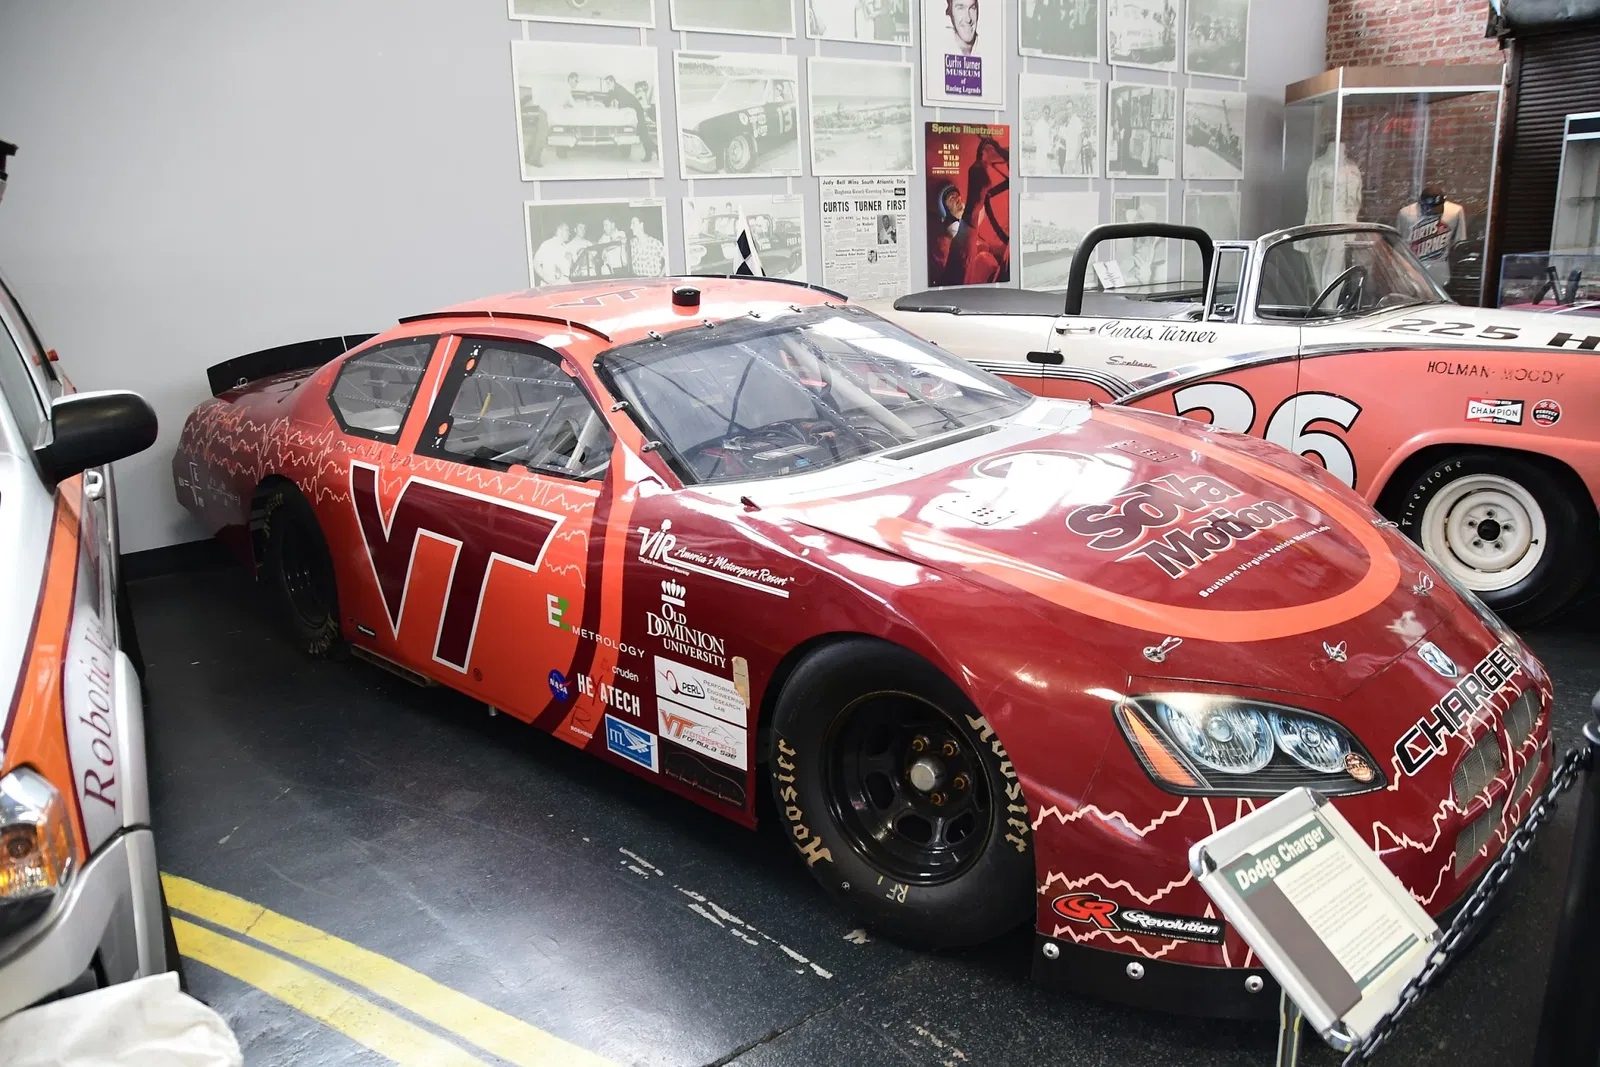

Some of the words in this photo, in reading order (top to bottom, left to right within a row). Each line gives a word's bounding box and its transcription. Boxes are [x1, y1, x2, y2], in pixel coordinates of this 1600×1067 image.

[945, 54, 962, 69] Curtis
[963, 57, 980, 70] Turner
[945, 69, 980, 78] MUSEUM
[945, 85, 962, 93] Racing
[962, 86, 980, 94] Legends
[932, 124, 960, 134] Sports
[963, 125, 1004, 136] Illustrated
[823, 201, 850, 212] CURTIS
[854, 200, 882, 212] TURNER
[886, 200, 906, 210] FIRST
[1098, 321, 1153, 340] Curtis
[1158, 325, 1218, 344] Turner
[1387, 318, 1522, 340] 225
[1470, 406, 1518, 416] CHAMPION
[1401, 461, 1461, 526] Firestone
[1115, 499, 1299, 580] Motion
[350, 459, 567, 674] VT
[674, 546, 714, 565] America's
[713, 556, 759, 578] Motorsport
[758, 568, 788, 586] Resort
[1198, 570, 1241, 598] Southern
[1238, 552, 1271, 571] Virginia
[1268, 540, 1296, 554] Vehicle
[1293, 530, 1318, 542] Motion
[661, 603, 687, 625] OLD
[572, 625, 645, 658] METROLOGY
[646, 611, 725, 656] DOMINION
[663, 637, 726, 669] UNIVERSITY
[612, 666, 639, 682] cruden
[550, 678, 568, 694] NASA
[577, 673, 640, 717] HEXATECH
[682, 682, 701, 694] PERL
[703, 680, 740, 697] PERFORMAN
[707, 688, 744, 706] ENGINEERING
[710, 696, 740, 711] RESEARCH
[79, 655, 116, 814] Robotic
[659, 709, 696, 739] VT
[773, 738, 834, 868] Hoosier
[1235, 856, 1282, 891] Dodge
[1278, 826, 1326, 862] Charger
